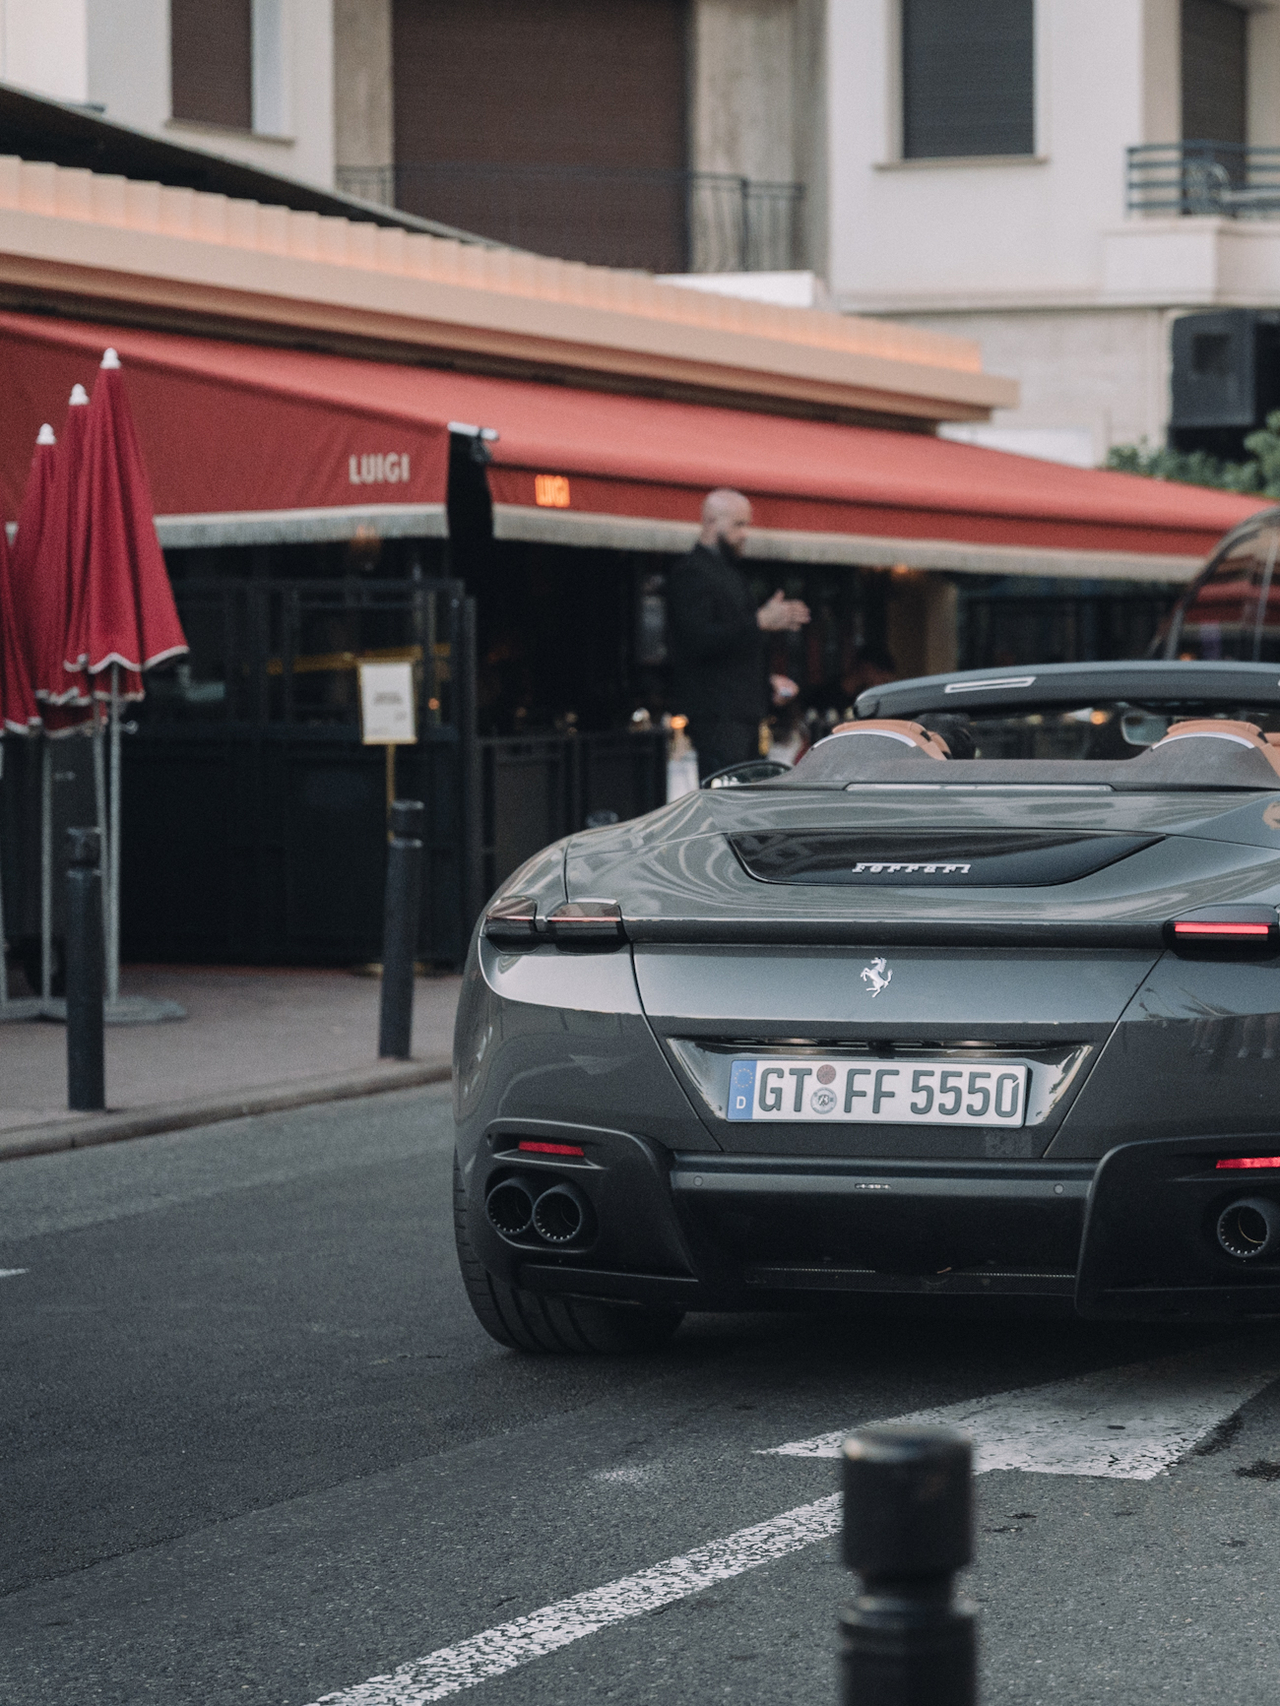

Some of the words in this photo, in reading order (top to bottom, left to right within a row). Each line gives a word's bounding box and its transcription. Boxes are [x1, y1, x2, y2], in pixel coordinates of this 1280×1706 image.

[349, 452, 411, 484] LUIGI
[736, 1096, 746, 1109] D
[758, 1067, 812, 1112] GT
[844, 1068, 900, 1114] FF
[910, 1070, 1019, 1118] 5550
